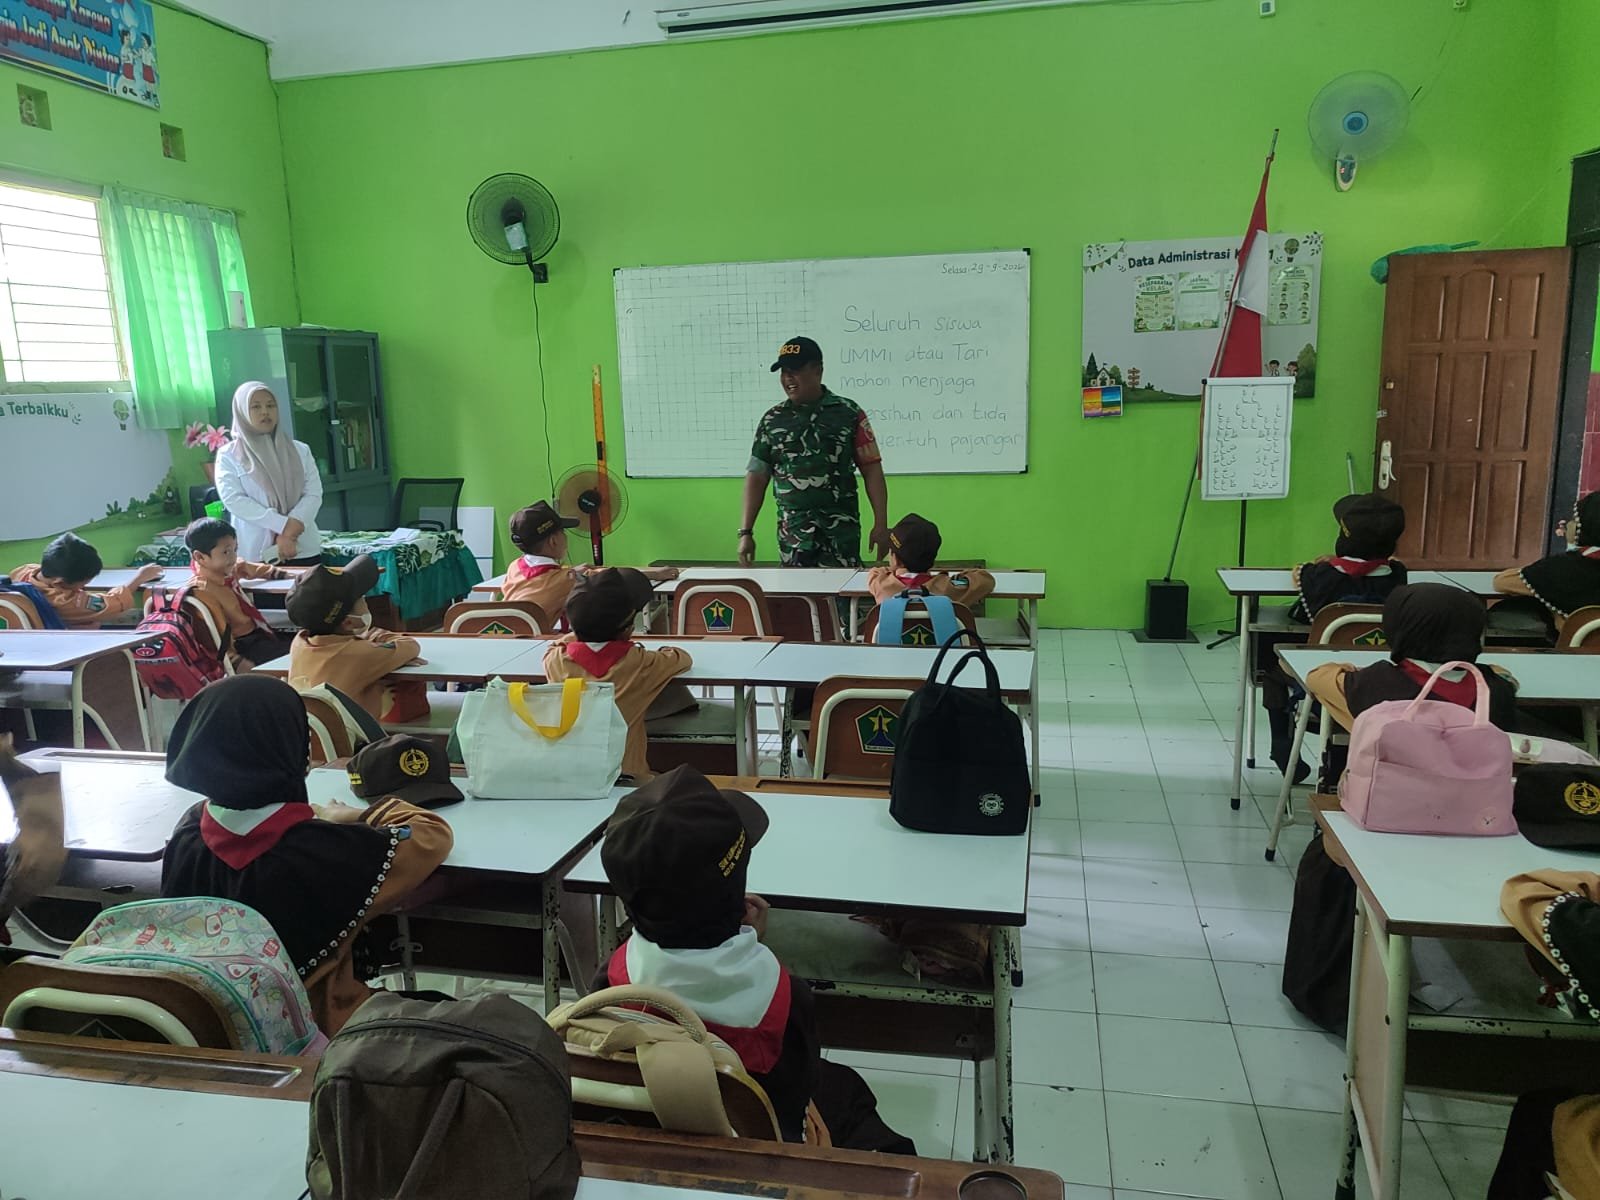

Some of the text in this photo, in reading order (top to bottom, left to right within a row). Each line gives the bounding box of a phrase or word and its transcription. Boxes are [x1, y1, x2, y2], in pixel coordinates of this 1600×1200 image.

[51, 25, 83, 63] Anak
[1127, 255, 1155, 269] Data
[1157, 249, 1231, 265] Administrasi
[843, 304, 982, 333] Seluruh siswa
[904, 345, 944, 362] atau
[951, 342, 990, 361] Tari
[840, 372, 976, 396] mohon menjaga
[6, 401, 69, 418] Terbaikku
[932, 402, 963, 420] dan
